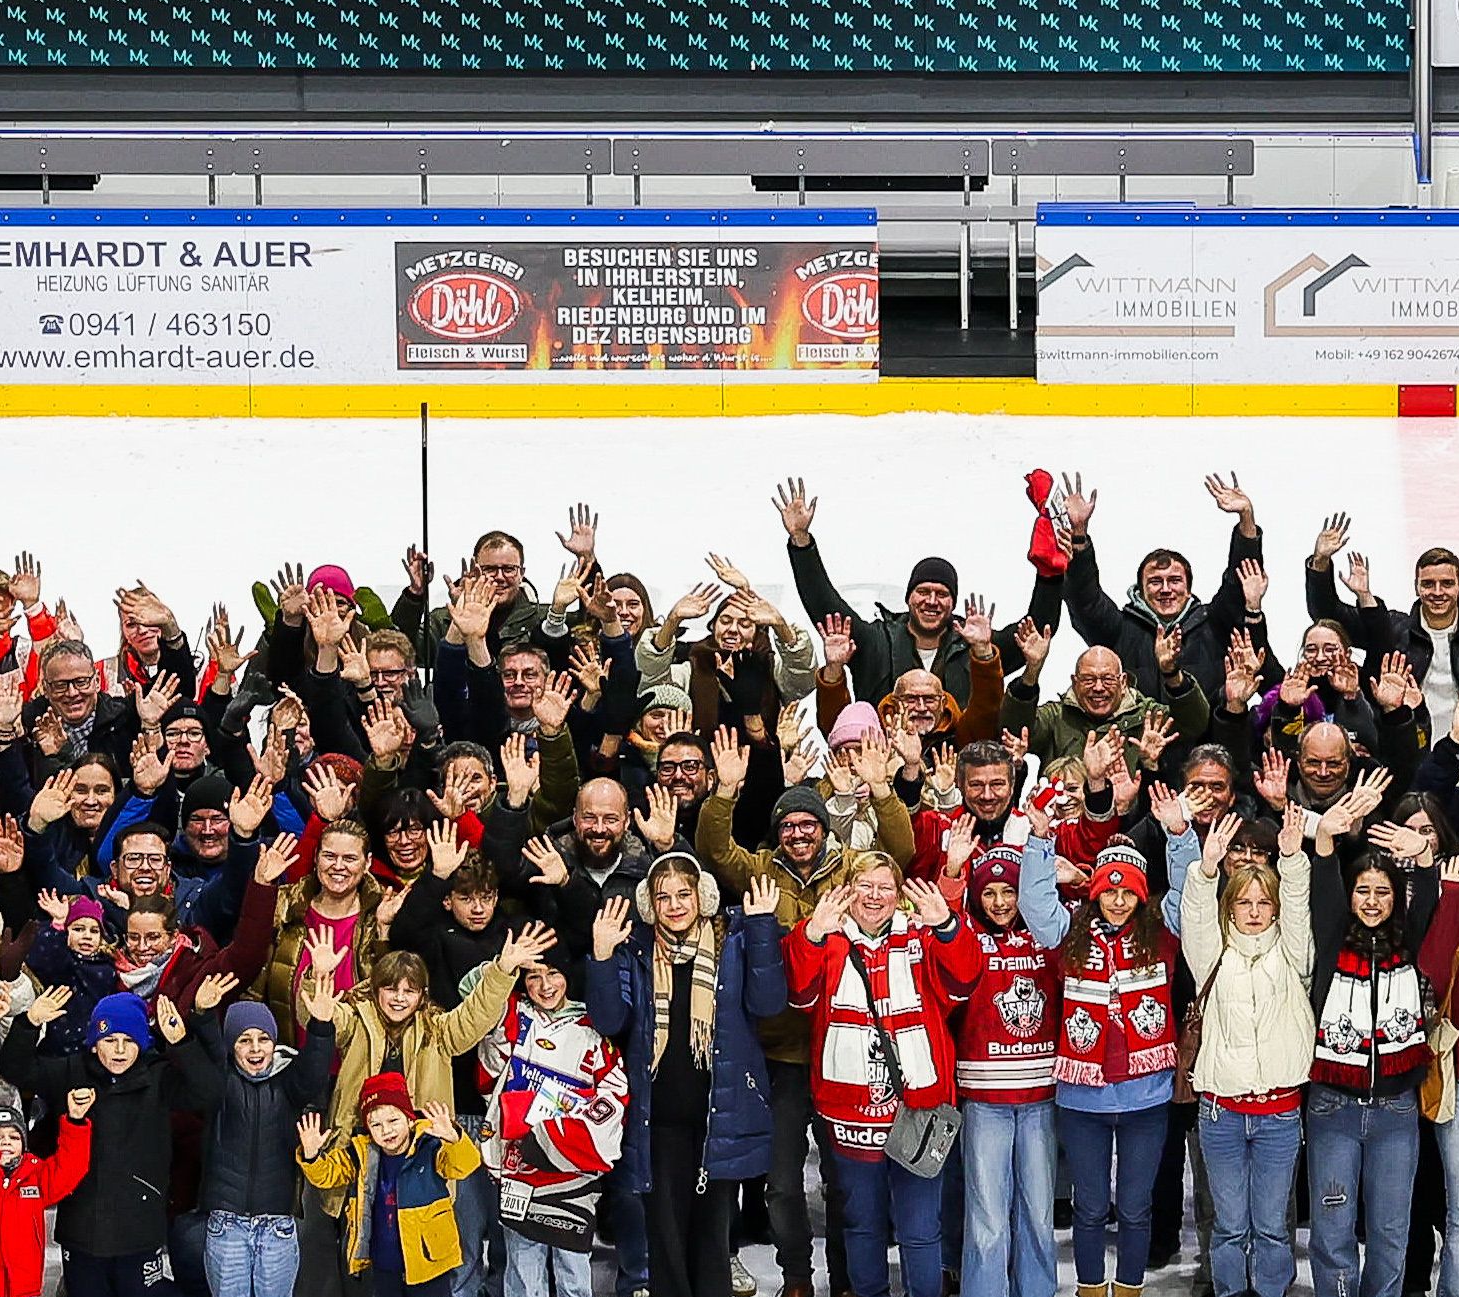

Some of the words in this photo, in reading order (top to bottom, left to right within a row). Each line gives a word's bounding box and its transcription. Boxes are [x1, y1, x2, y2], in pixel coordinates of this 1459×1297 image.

[178, 241, 204, 268] &
[213, 241, 313, 268] AUER
[563, 248, 672, 268] BESUCHEN
[677, 248, 708, 268] SIE
[715, 248, 758, 268] UNS
[404, 250, 525, 281] METZGEREI
[795, 250, 879, 282] METZGE
[36, 274, 108, 293] HEIZUNG
[116, 271, 192, 293] LÜFTUNG
[200, 271, 270, 293] SANITÄR
[576, 268, 601, 287] IN
[605, 268, 746, 290] IHRLERSTEIN,
[1075, 277, 1237, 294] WITTMANN
[431, 282, 503, 328] Döhl
[612, 288, 711, 308] KELHEIM,
[821, 282, 879, 328] Döh
[556, 307, 688, 326] RIEDENBURG
[691, 307, 737, 326] UND
[741, 307, 766, 326] IM
[1115, 300, 1237, 318] IMMOBILIEN
[68, 312, 136, 337] 0941
[148, 312, 157, 337] /
[165, 312, 272, 337] 463150
[571, 326, 612, 345] DEZ
[617, 326, 752, 346] REGENSBURG
[408, 344, 460, 360] Fleisch
[465, 345, 477, 360] &
[480, 344, 526, 360] Wurst
[797, 345, 850, 359] Fleisch
[1315, 349, 1354, 362] Mobil:
[1357, 349, 1382, 362] +49
[1384, 349, 1405, 362] 162
[987, 1039, 1055, 1055] Buderus
[833, 1124, 888, 1145] Bude
